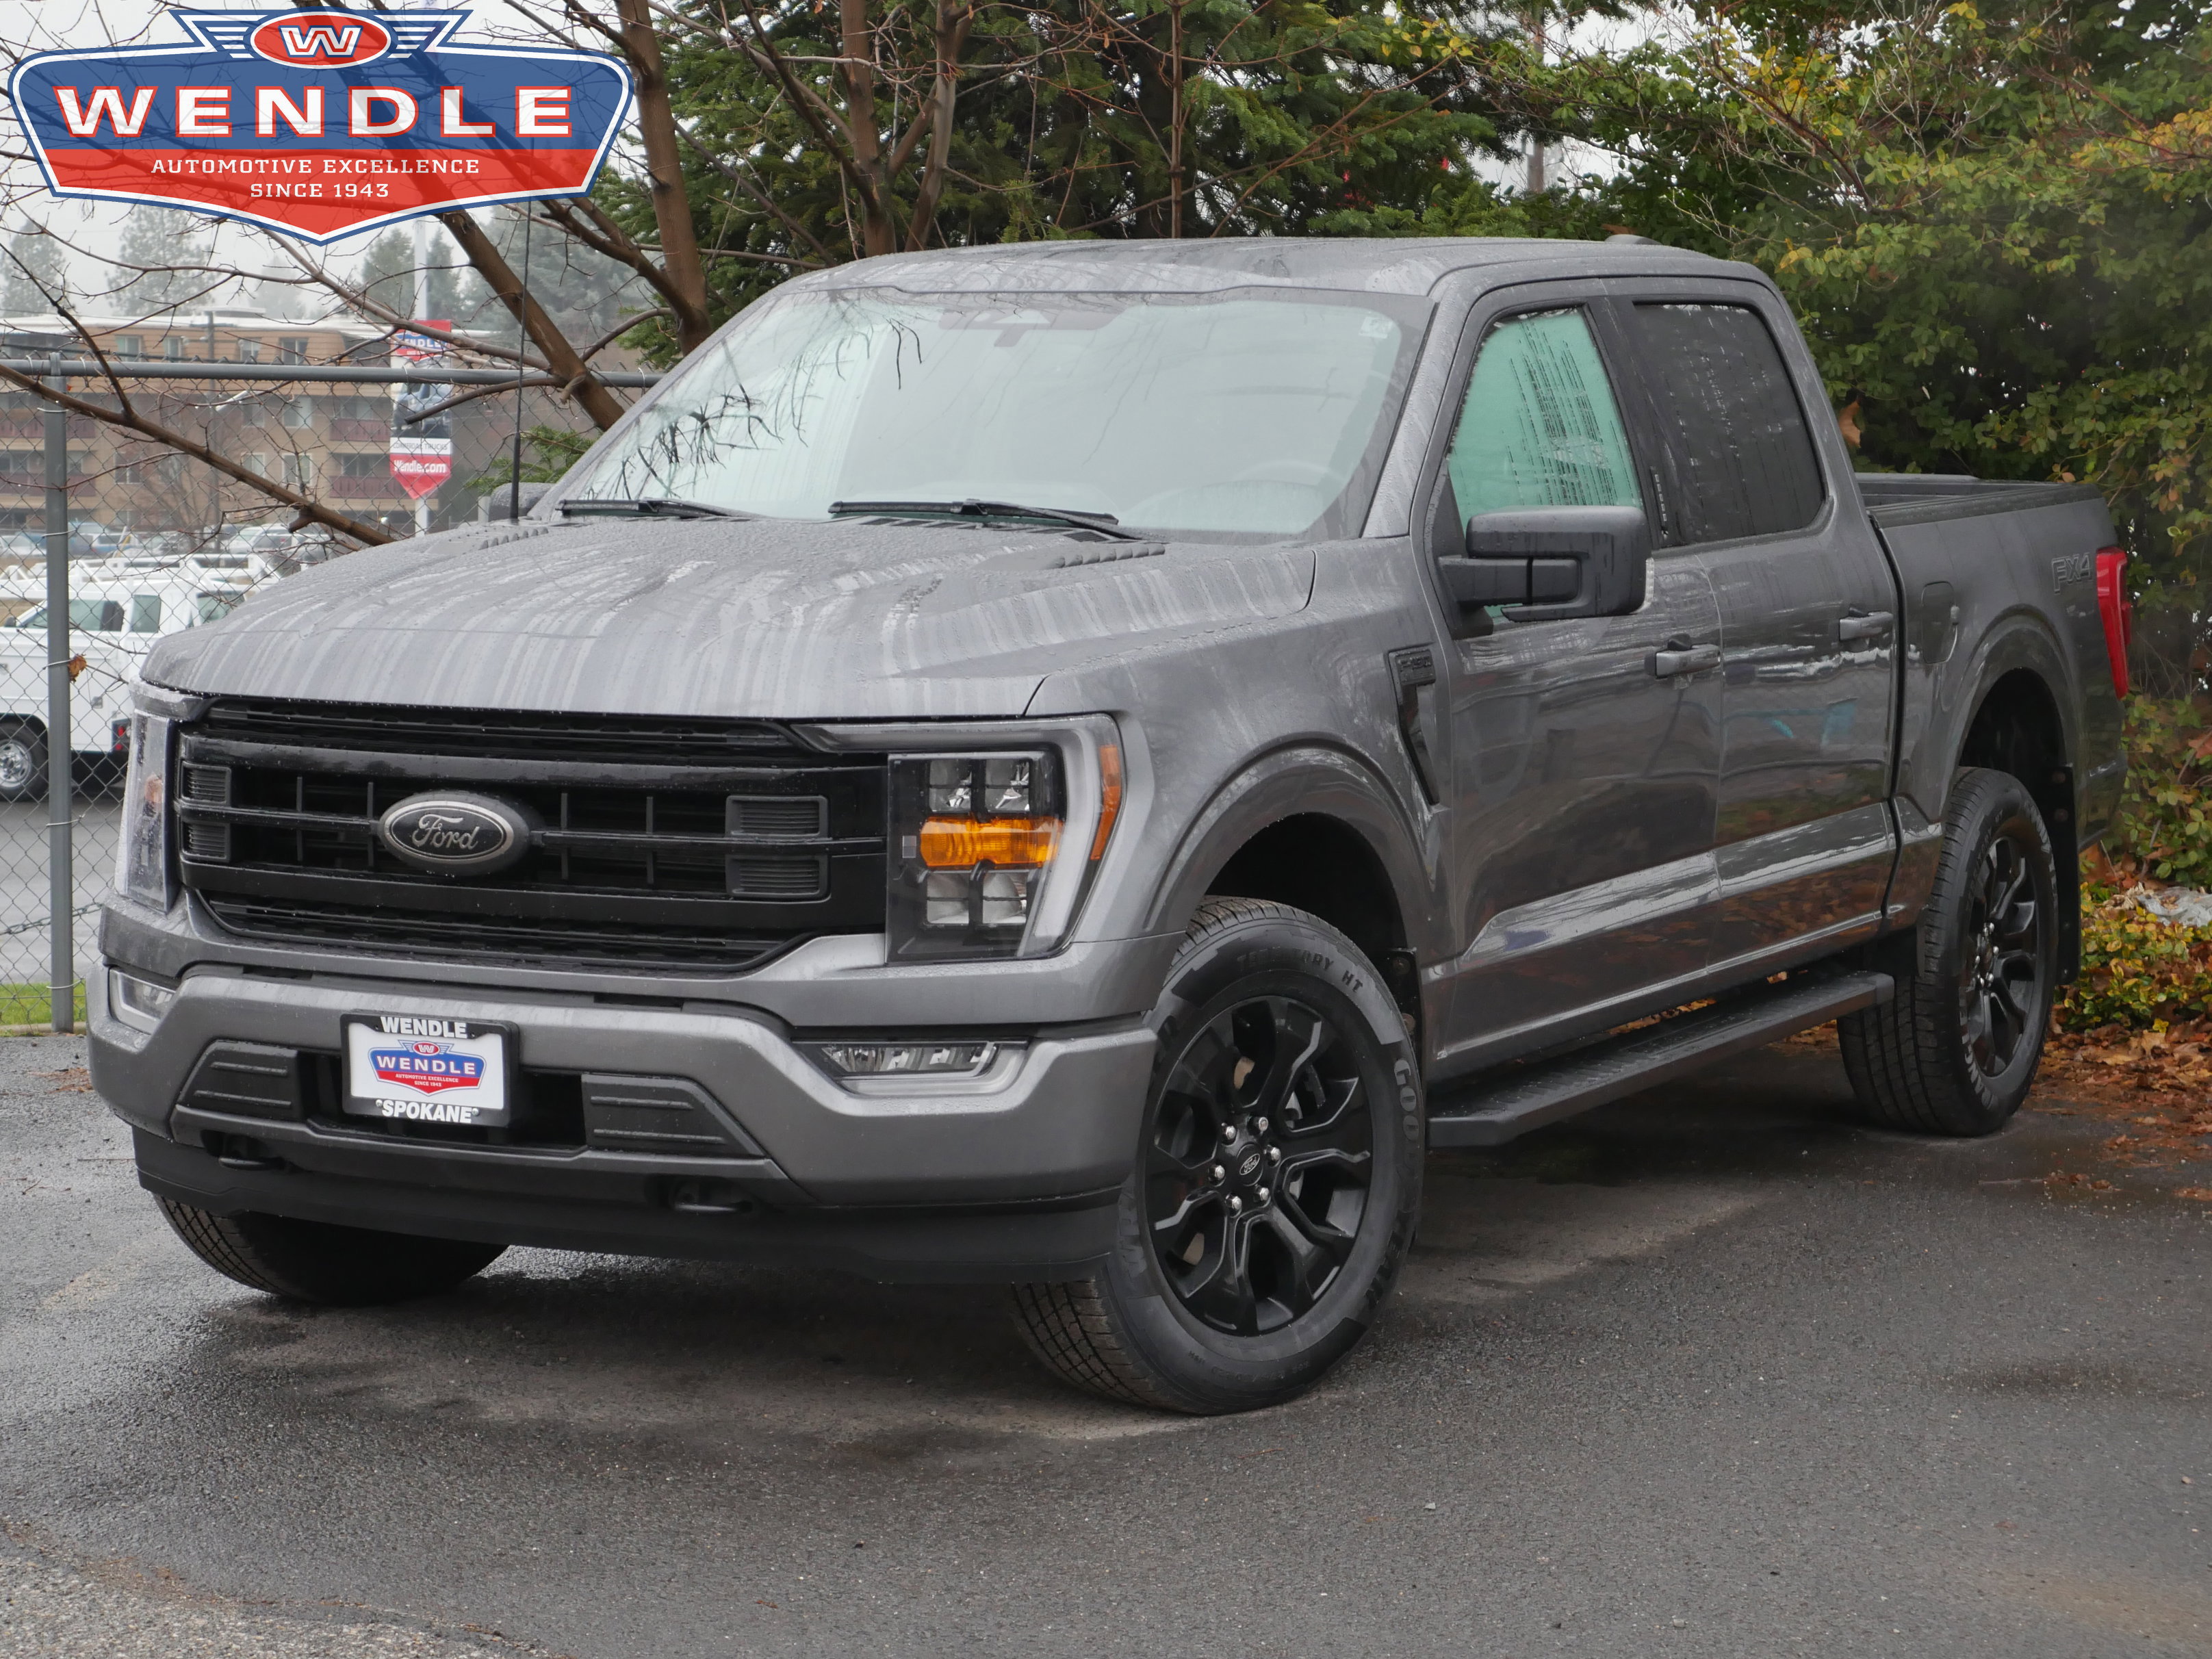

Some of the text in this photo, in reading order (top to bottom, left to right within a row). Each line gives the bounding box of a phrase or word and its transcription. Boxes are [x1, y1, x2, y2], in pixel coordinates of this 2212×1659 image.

[394, 459, 447, 473] Wendle.com
[2052, 552, 2093, 595] FX4
[412, 813, 480, 850] Ford
[1342, 970, 1363, 993] HT
[380, 1016, 467, 1038] WENDLE
[376, 1055, 476, 1075] WENDLE
[382, 1098, 472, 1123] SPOKANE
